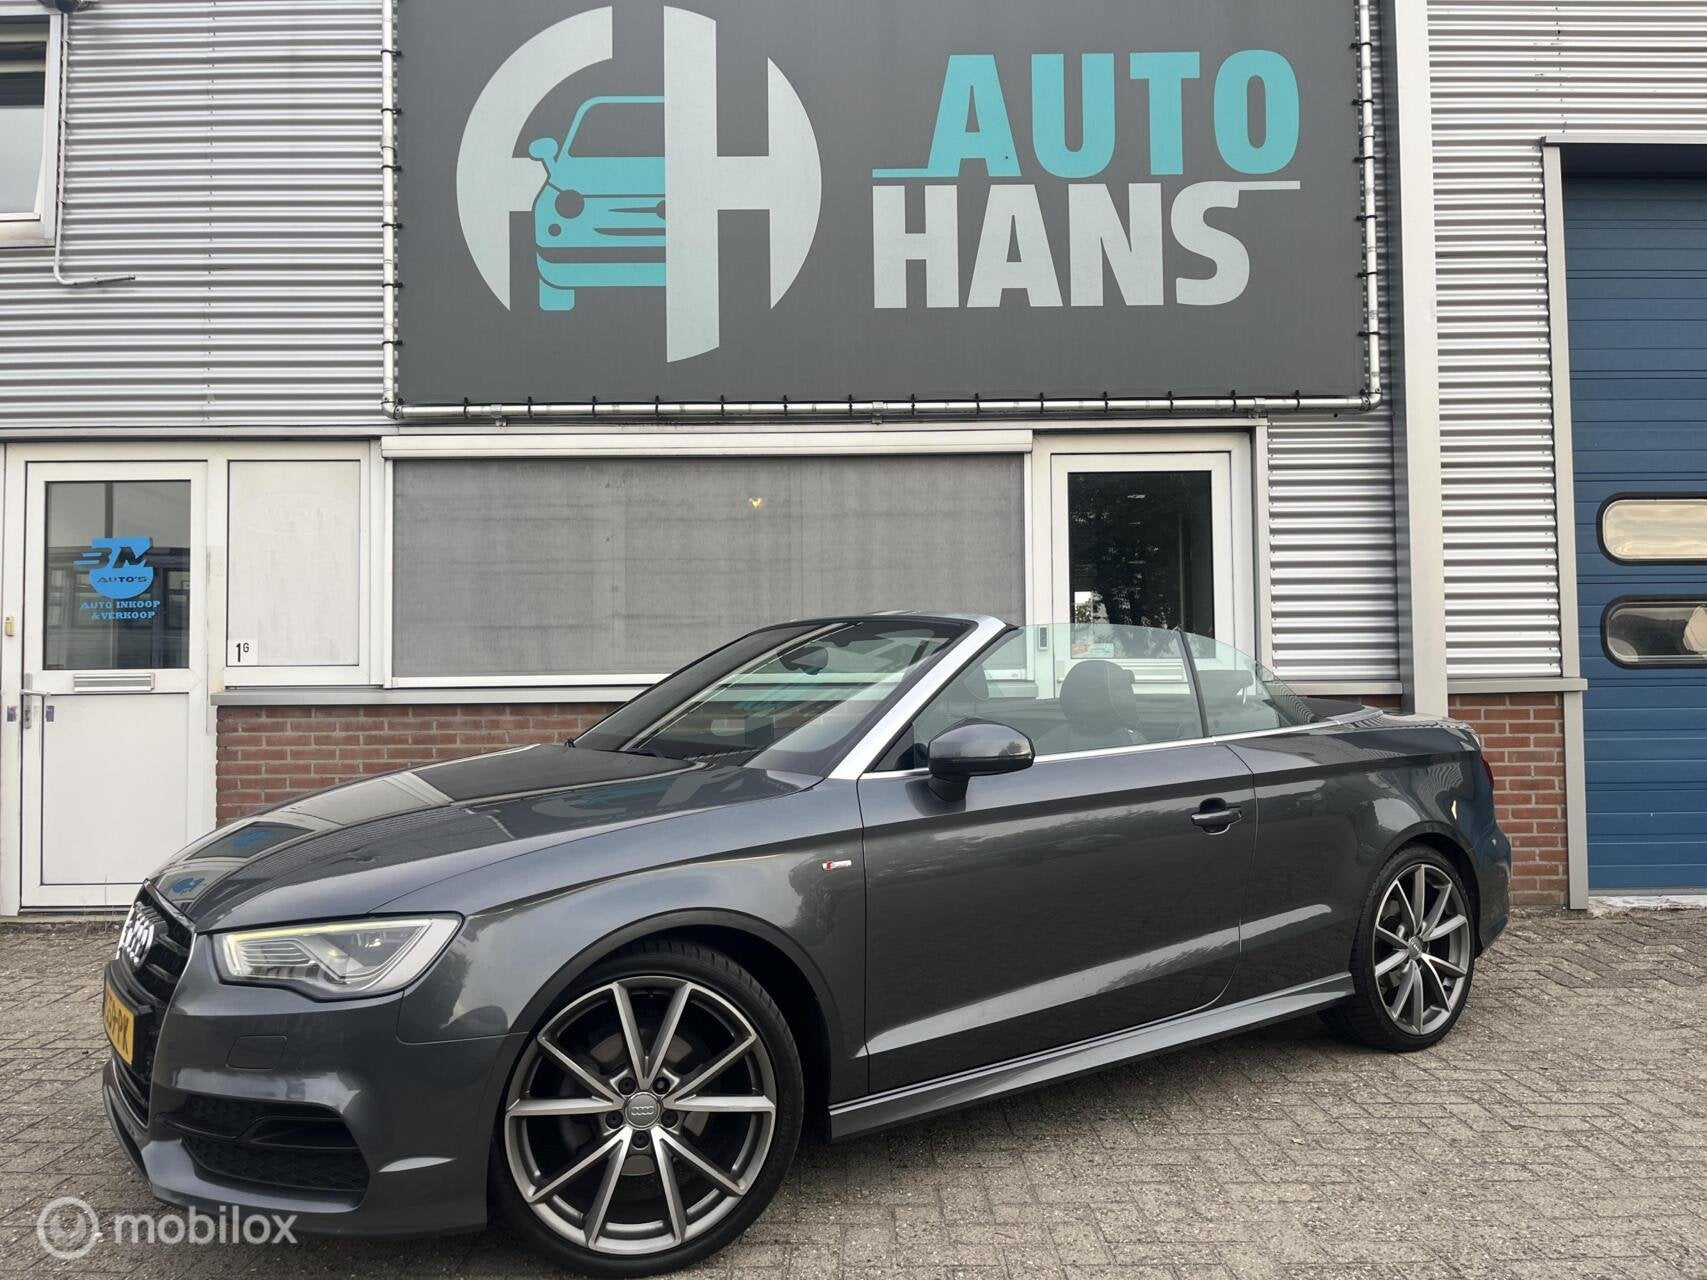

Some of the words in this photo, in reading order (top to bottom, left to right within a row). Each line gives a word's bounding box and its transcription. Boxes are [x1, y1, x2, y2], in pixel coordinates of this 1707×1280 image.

[872, 49, 1300, 178] AUTO
[872, 181, 1300, 309] HANS
[80, 601, 113, 610] AUTO
[116, 600, 161, 609] INKOOP
